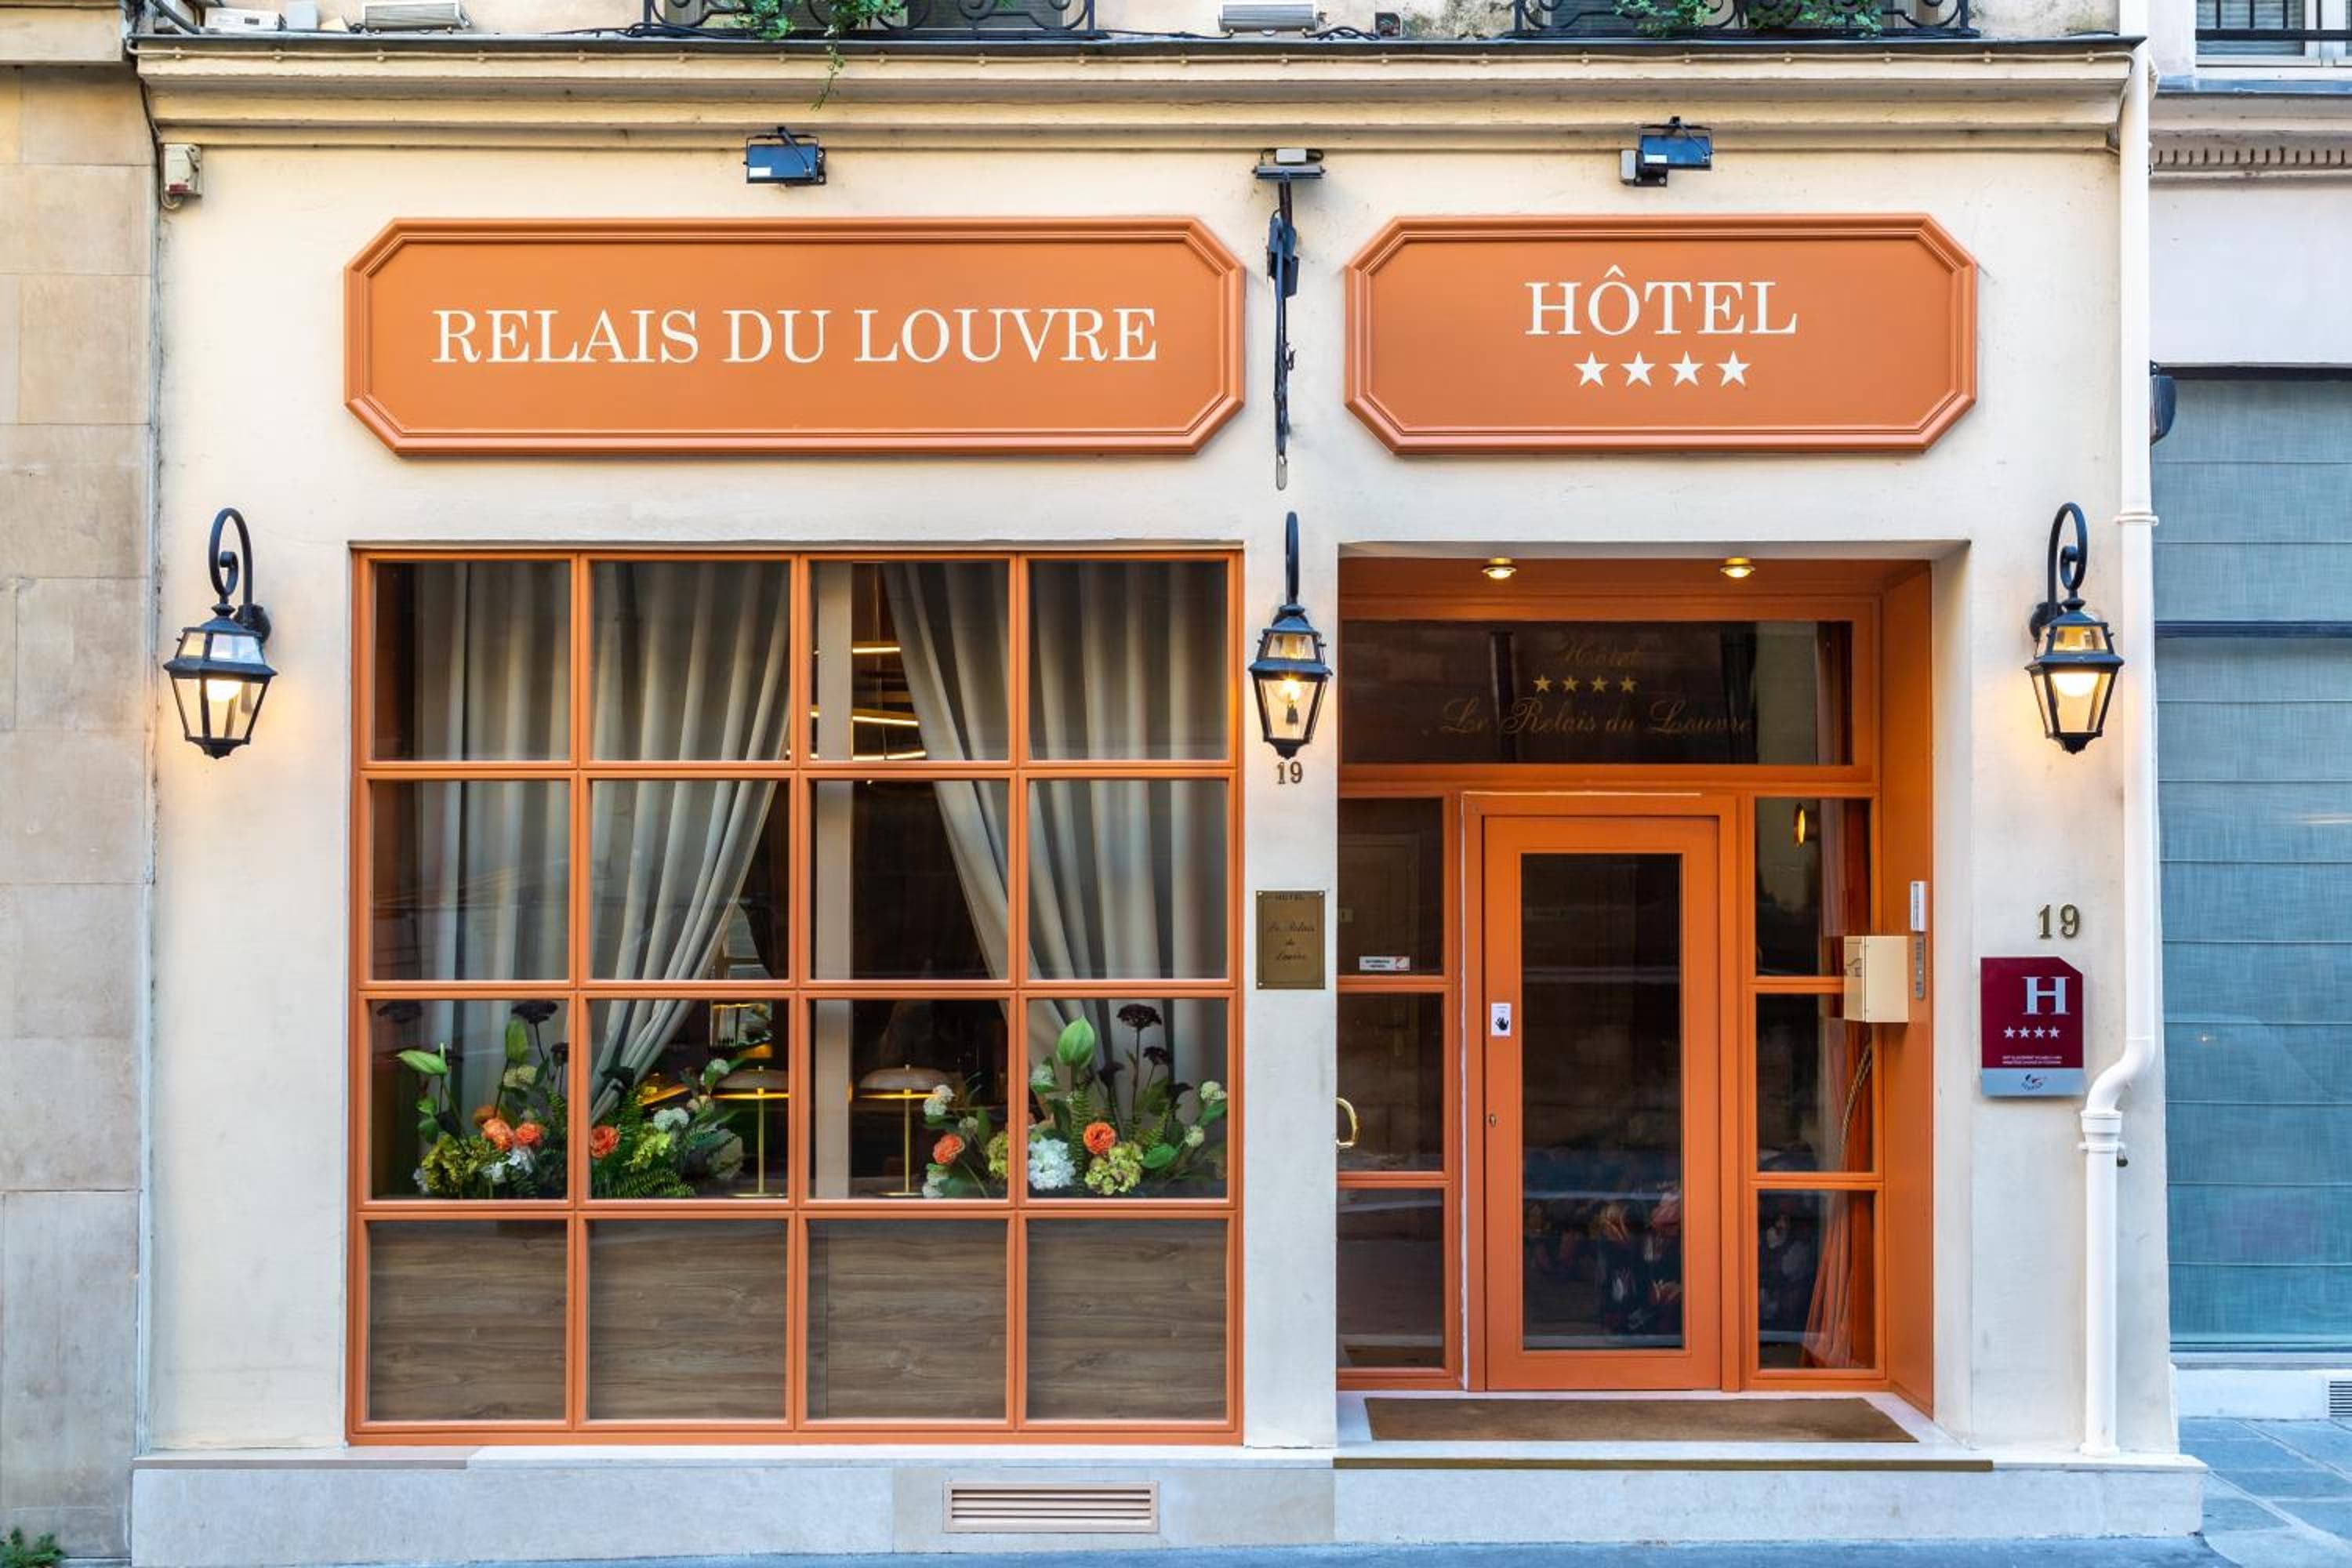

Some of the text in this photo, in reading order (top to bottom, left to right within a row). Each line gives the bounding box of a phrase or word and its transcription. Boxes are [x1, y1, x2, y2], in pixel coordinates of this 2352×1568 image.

[1524, 264, 1798, 336] HÔTEL
[432, 308, 1157, 365] RELAIS DU LOUVRE
[1276, 761, 1303, 785] 19
[2038, 903, 2080, 939] 19
[2021, 976, 2071, 1014] H
